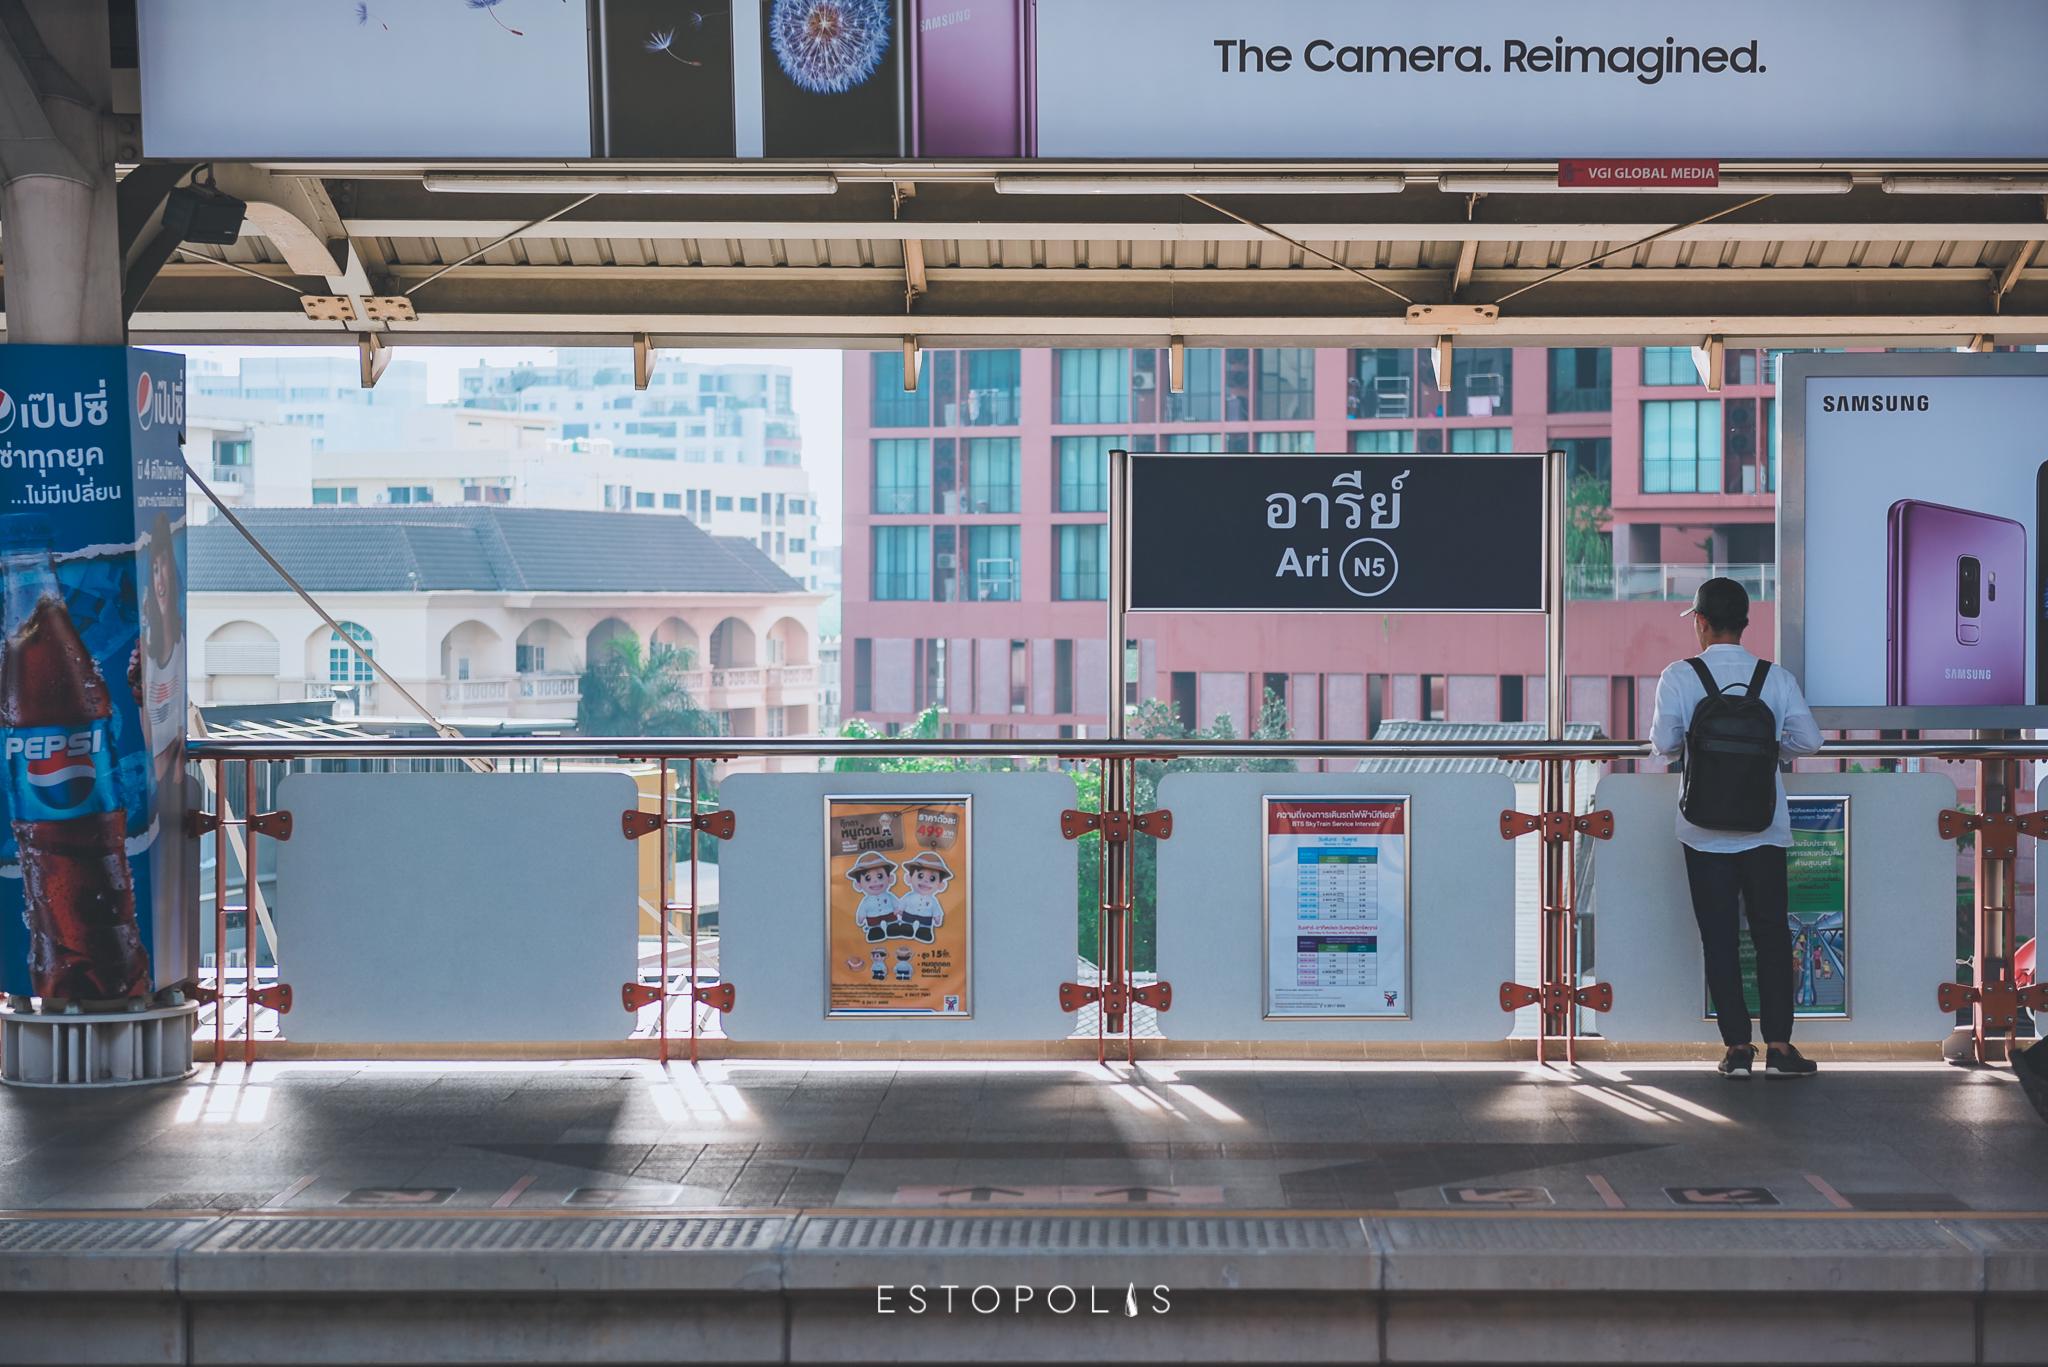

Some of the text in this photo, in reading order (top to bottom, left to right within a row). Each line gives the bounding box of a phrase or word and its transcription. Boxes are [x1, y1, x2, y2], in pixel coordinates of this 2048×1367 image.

[920, 9, 972, 33] SAMSUNG
[1213, 36, 1767, 84] The Camera. Reimagined.
[1588, 167, 1715, 179] VGI GLOBAL MEDIA
[20, 379, 109, 429] เป๊ปซี่
[154, 369, 184, 425] เป๊ปซี่
[1823, 395, 1930, 413] SAMSUNG
[0, 441, 104, 478] ซ่าทุกยุค
[144, 458, 151, 479] 4
[1265, 469, 1411, 530] อารีย์
[1275, 547, 1386, 578] Ari N5
[1944, 668, 1992, 681] SAMSUNG
[5, 729, 102, 760] PEPSI
[917, 825, 944, 838] 499
[931, 950, 943, 959] 15
